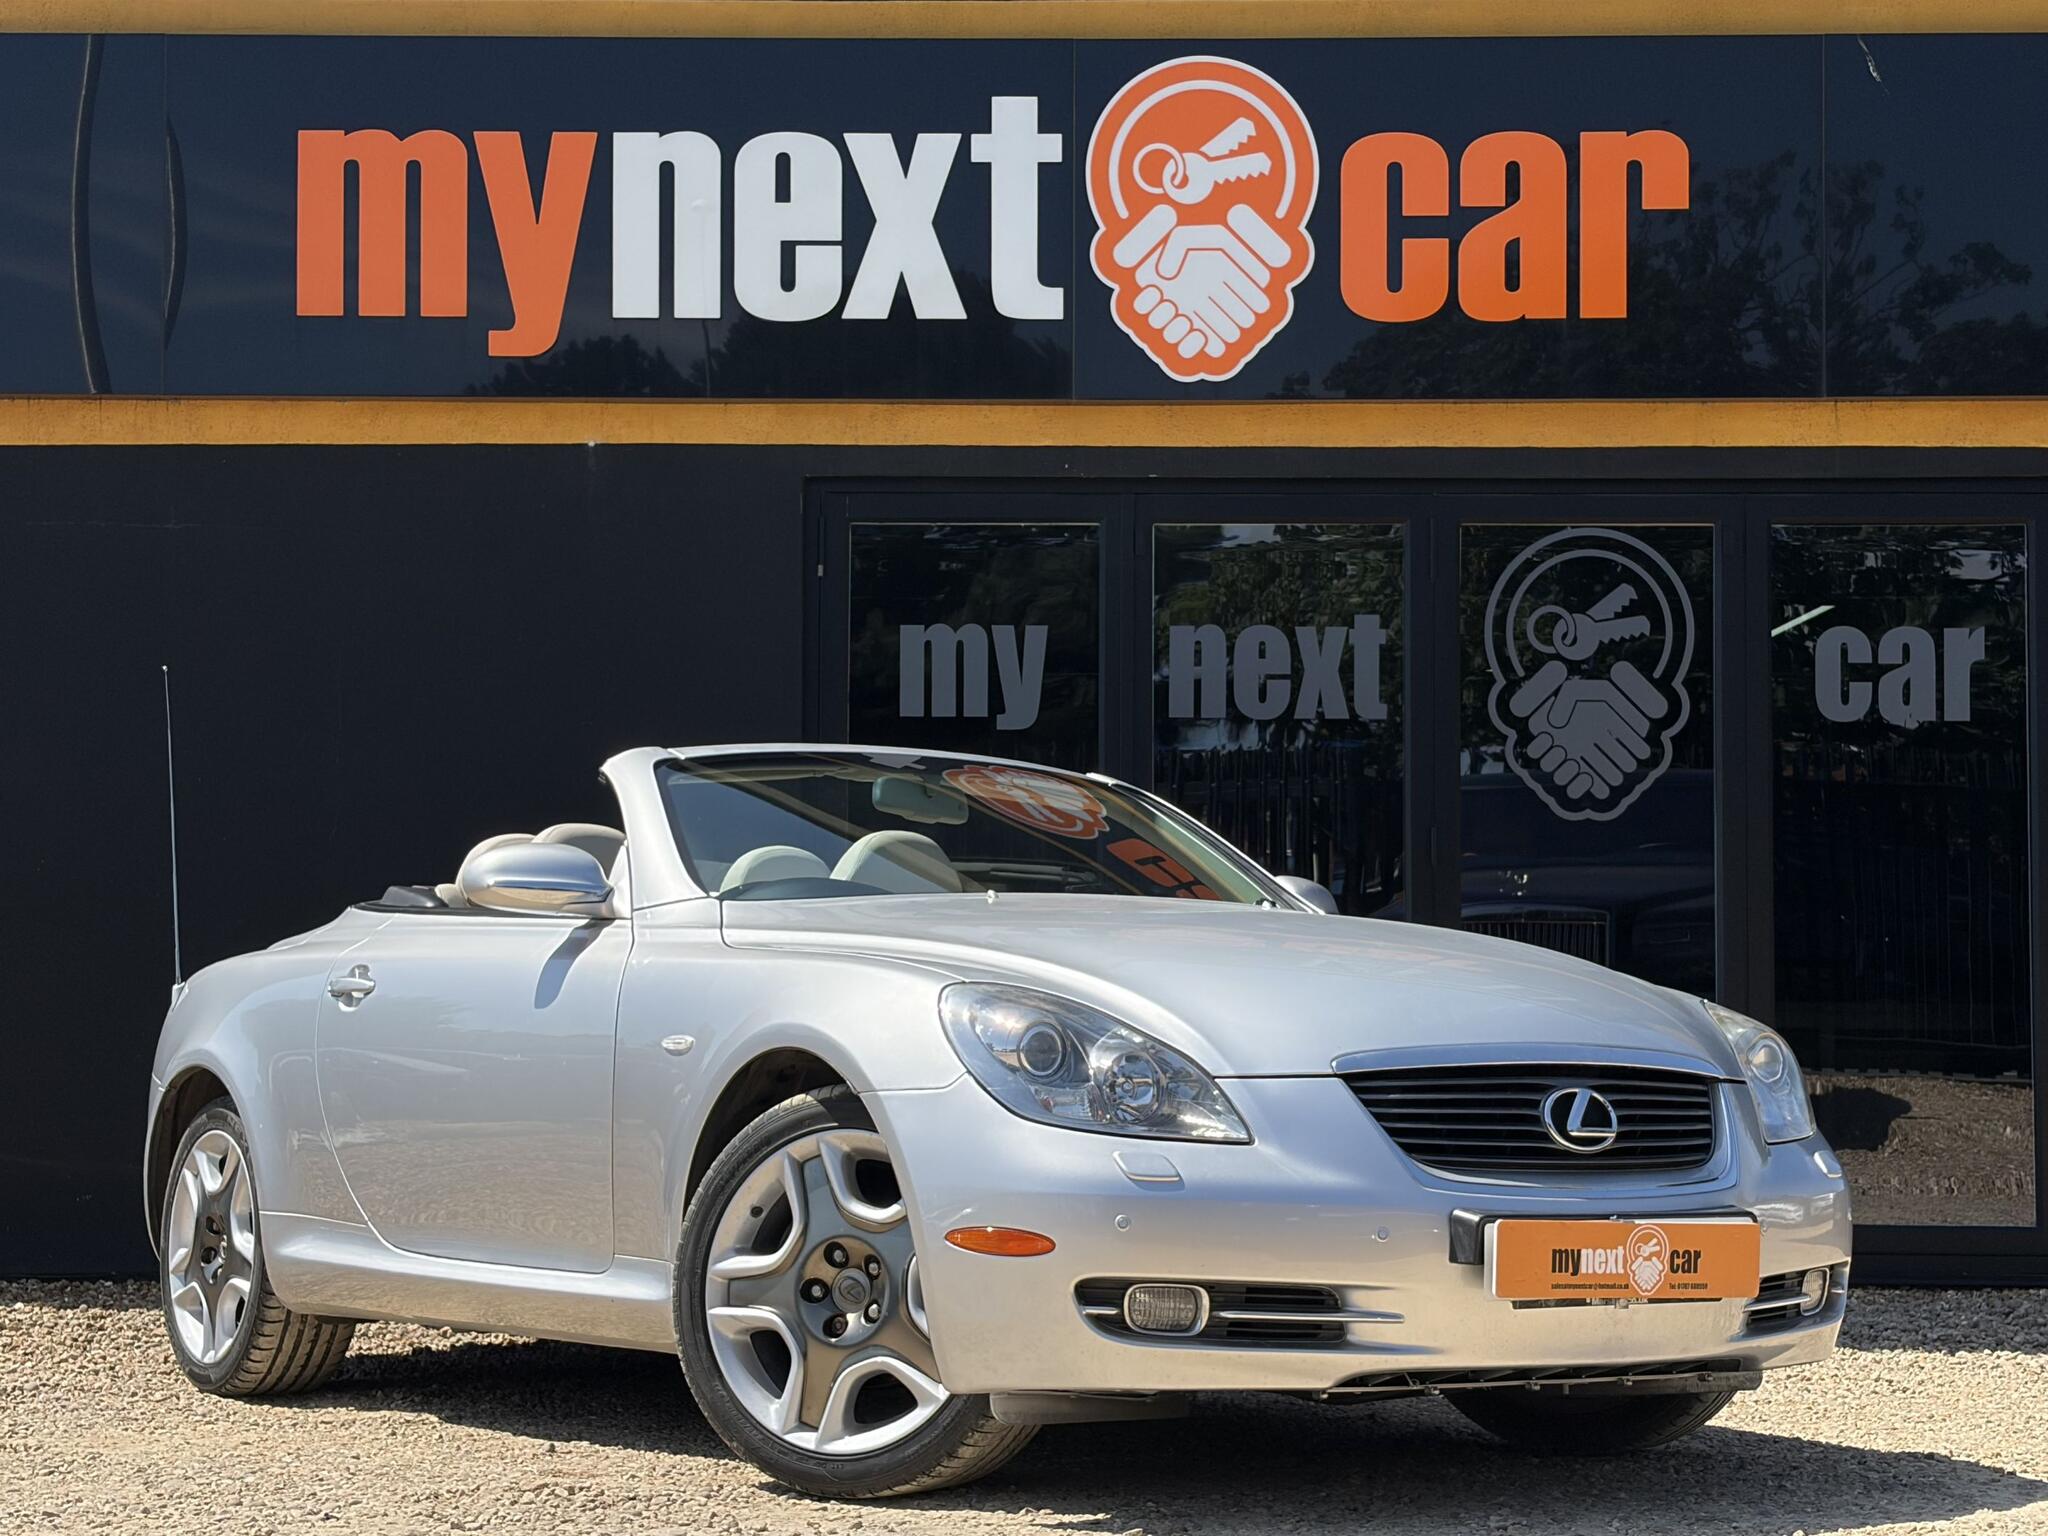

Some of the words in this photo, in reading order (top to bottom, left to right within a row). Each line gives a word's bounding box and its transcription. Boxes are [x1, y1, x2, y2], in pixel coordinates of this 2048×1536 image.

[1340, 129, 1689, 322] car
[900, 623, 1048, 731] my
[1168, 614, 1388, 720] next
[1814, 626, 1985, 724] car
[1669, 1249, 1701, 1273] car
